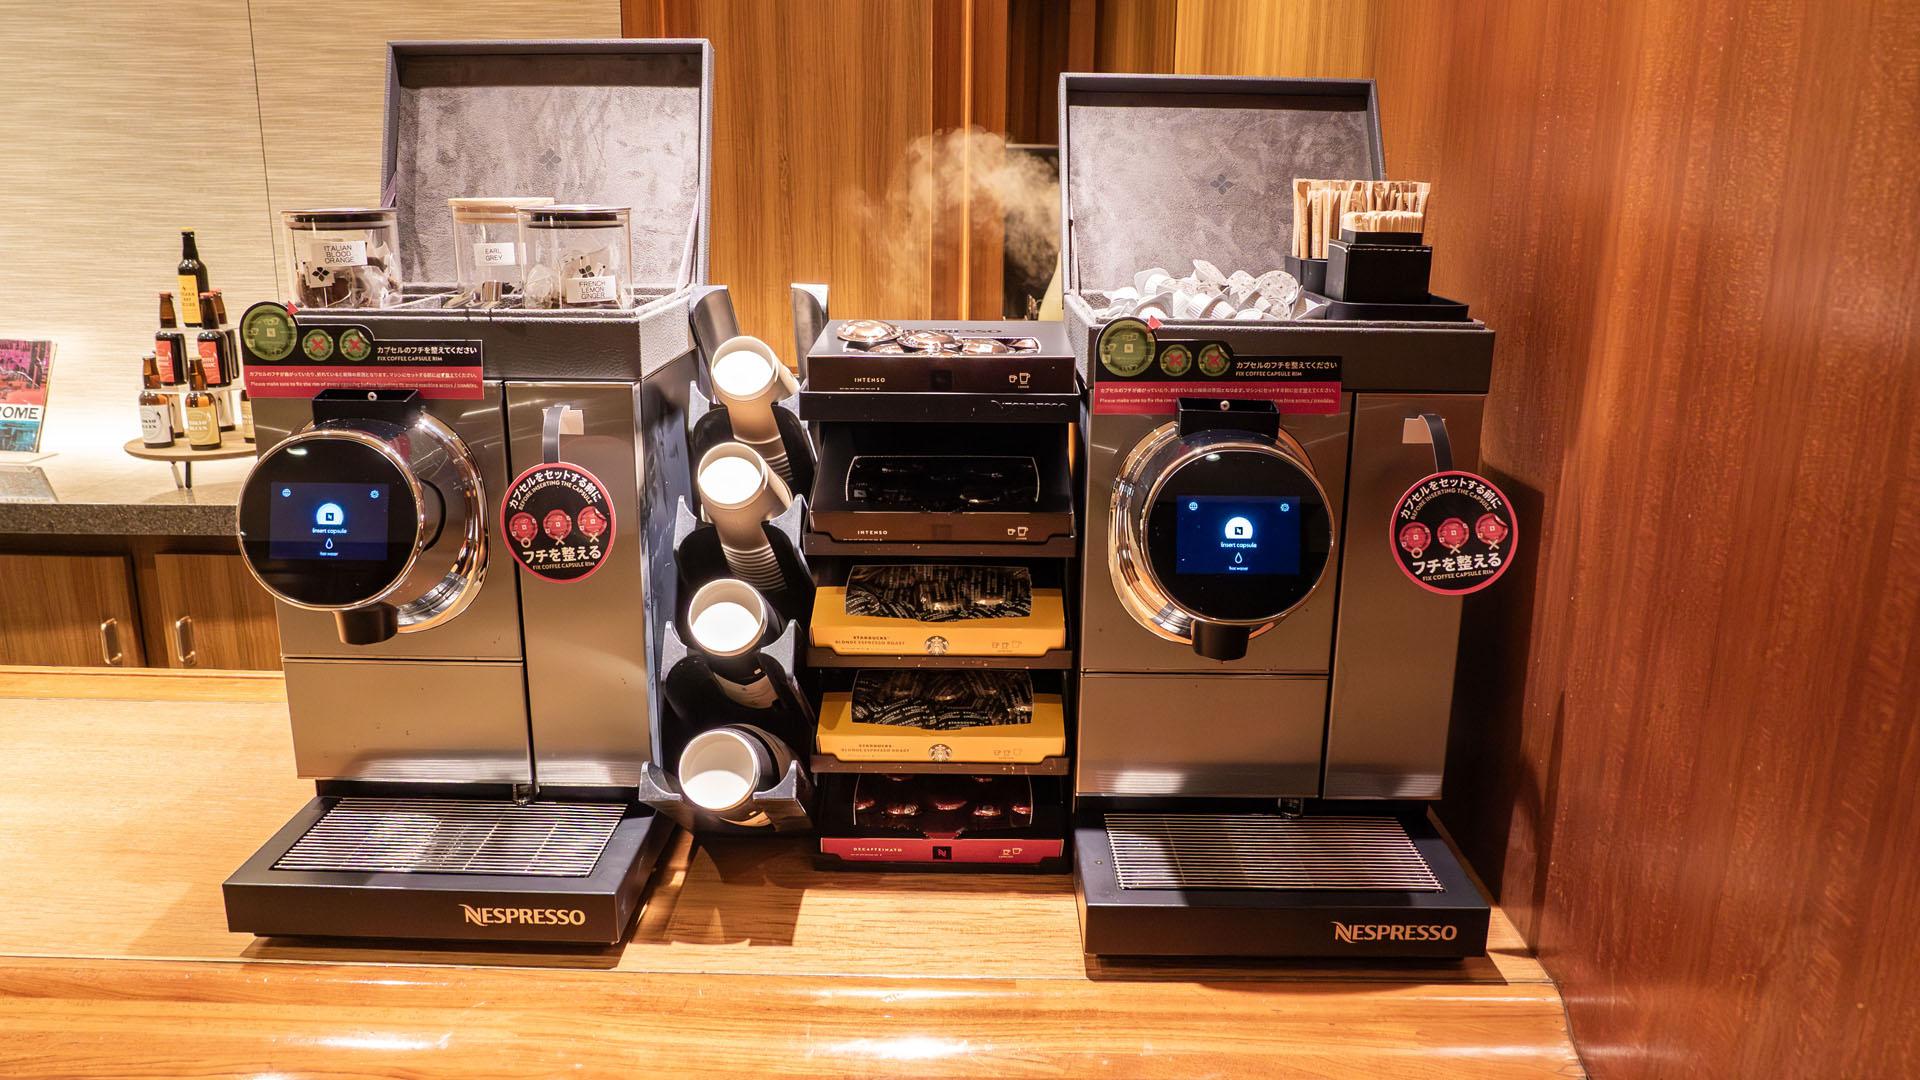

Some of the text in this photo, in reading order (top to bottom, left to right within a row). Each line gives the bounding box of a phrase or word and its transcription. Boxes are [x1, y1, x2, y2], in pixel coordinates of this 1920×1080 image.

[377, 346, 477, 354] カプセルのフチを整えてください
[1236, 361, 1337, 369] カプセルのフチを整えてください
[0, 406, 39, 420] OME
[508, 470, 602, 510] カプセルをセットする前に
[518, 490, 533, 510] BEFORE
[532, 480, 560, 494] INSERTING
[572, 484, 593, 504] CAPSULE
[1400, 477, 1502, 520] カプセルをセットする前に
[1410, 488, 1492, 520] BEFORE INSERTING THE CAPSULE
[522, 545, 602, 563] フチを整える
[1412, 552, 1502, 575] フチを整える
[1455, 570, 1482, 578] CAPSULE
[458, 903, 586, 927] NESPRESSO
[1330, 921, 1458, 944] NESPRESSO
